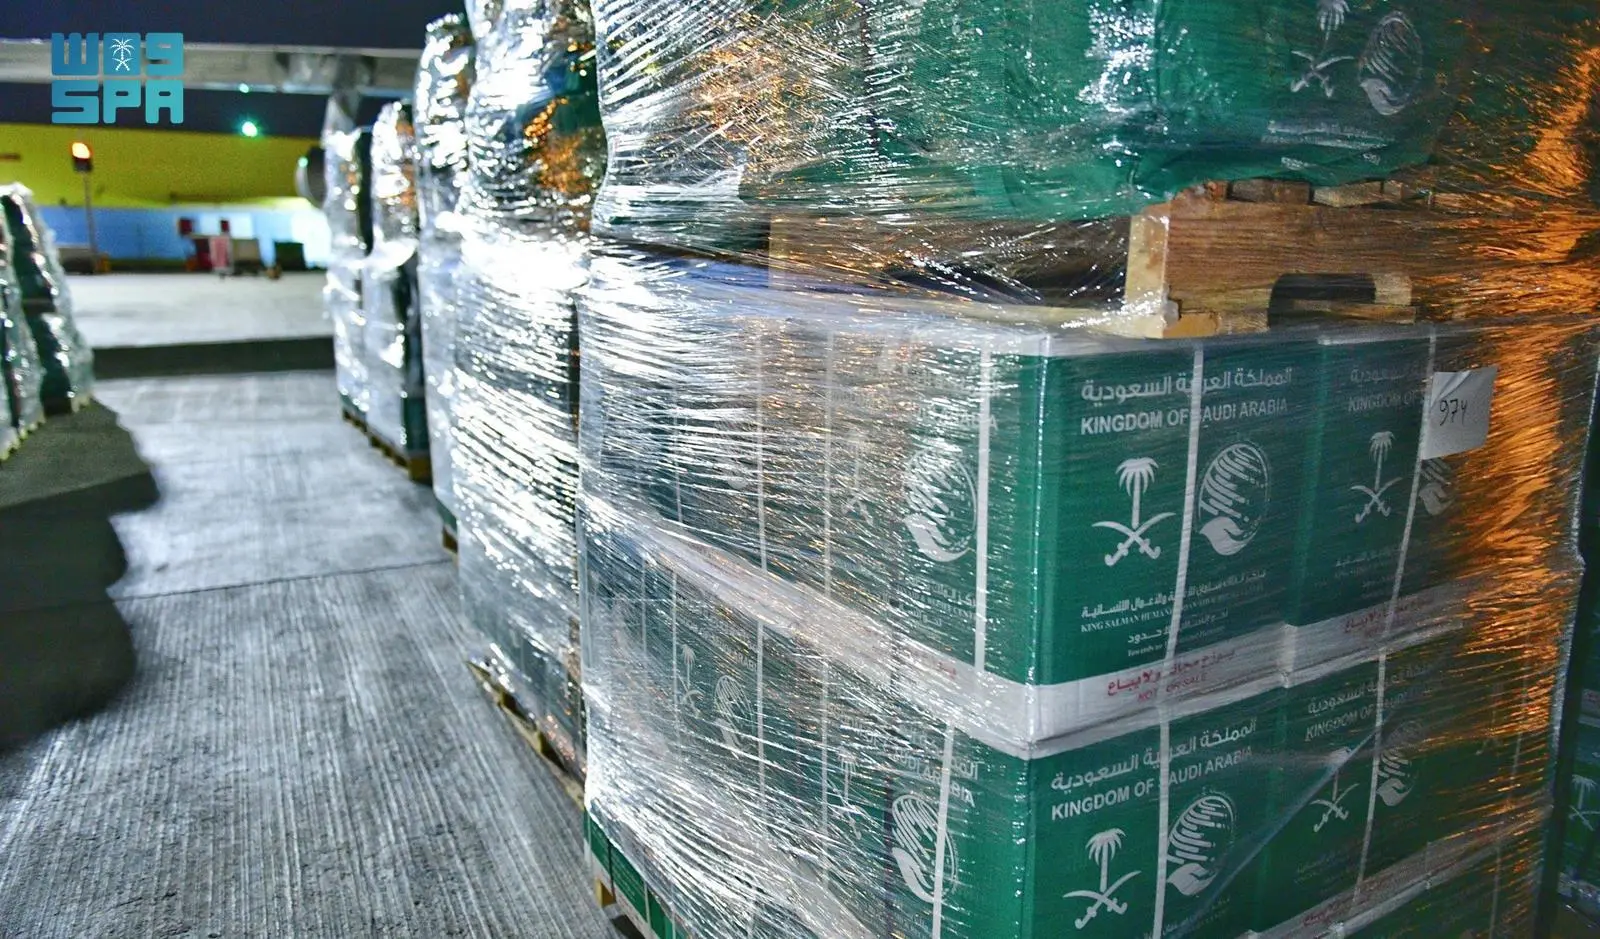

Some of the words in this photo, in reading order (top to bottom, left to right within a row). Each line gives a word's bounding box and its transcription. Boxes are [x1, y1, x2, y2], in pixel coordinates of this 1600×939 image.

[1080, 376, 1172, 408] السعودية
[1234, 367, 1293, 388] المملكة
[1081, 410, 1164, 435] KINGDOM
[1166, 408, 1190, 427] OF
[1197, 402, 1237, 425] AUDI
[1239, 397, 1288, 418] ARABIA
[1439, 398, 1468, 427] 974
[1201, 719, 1257, 747] المملكة
[1305, 709, 1359, 741] KINGDOM
[1051, 754, 1138, 794] السعودية
[1051, 786, 1130, 821] KINGDOM
[1134, 778, 1155, 798] OF
[1159, 763, 1203, 789] AUDI
[1204, 746, 1254, 775] ARABIA
